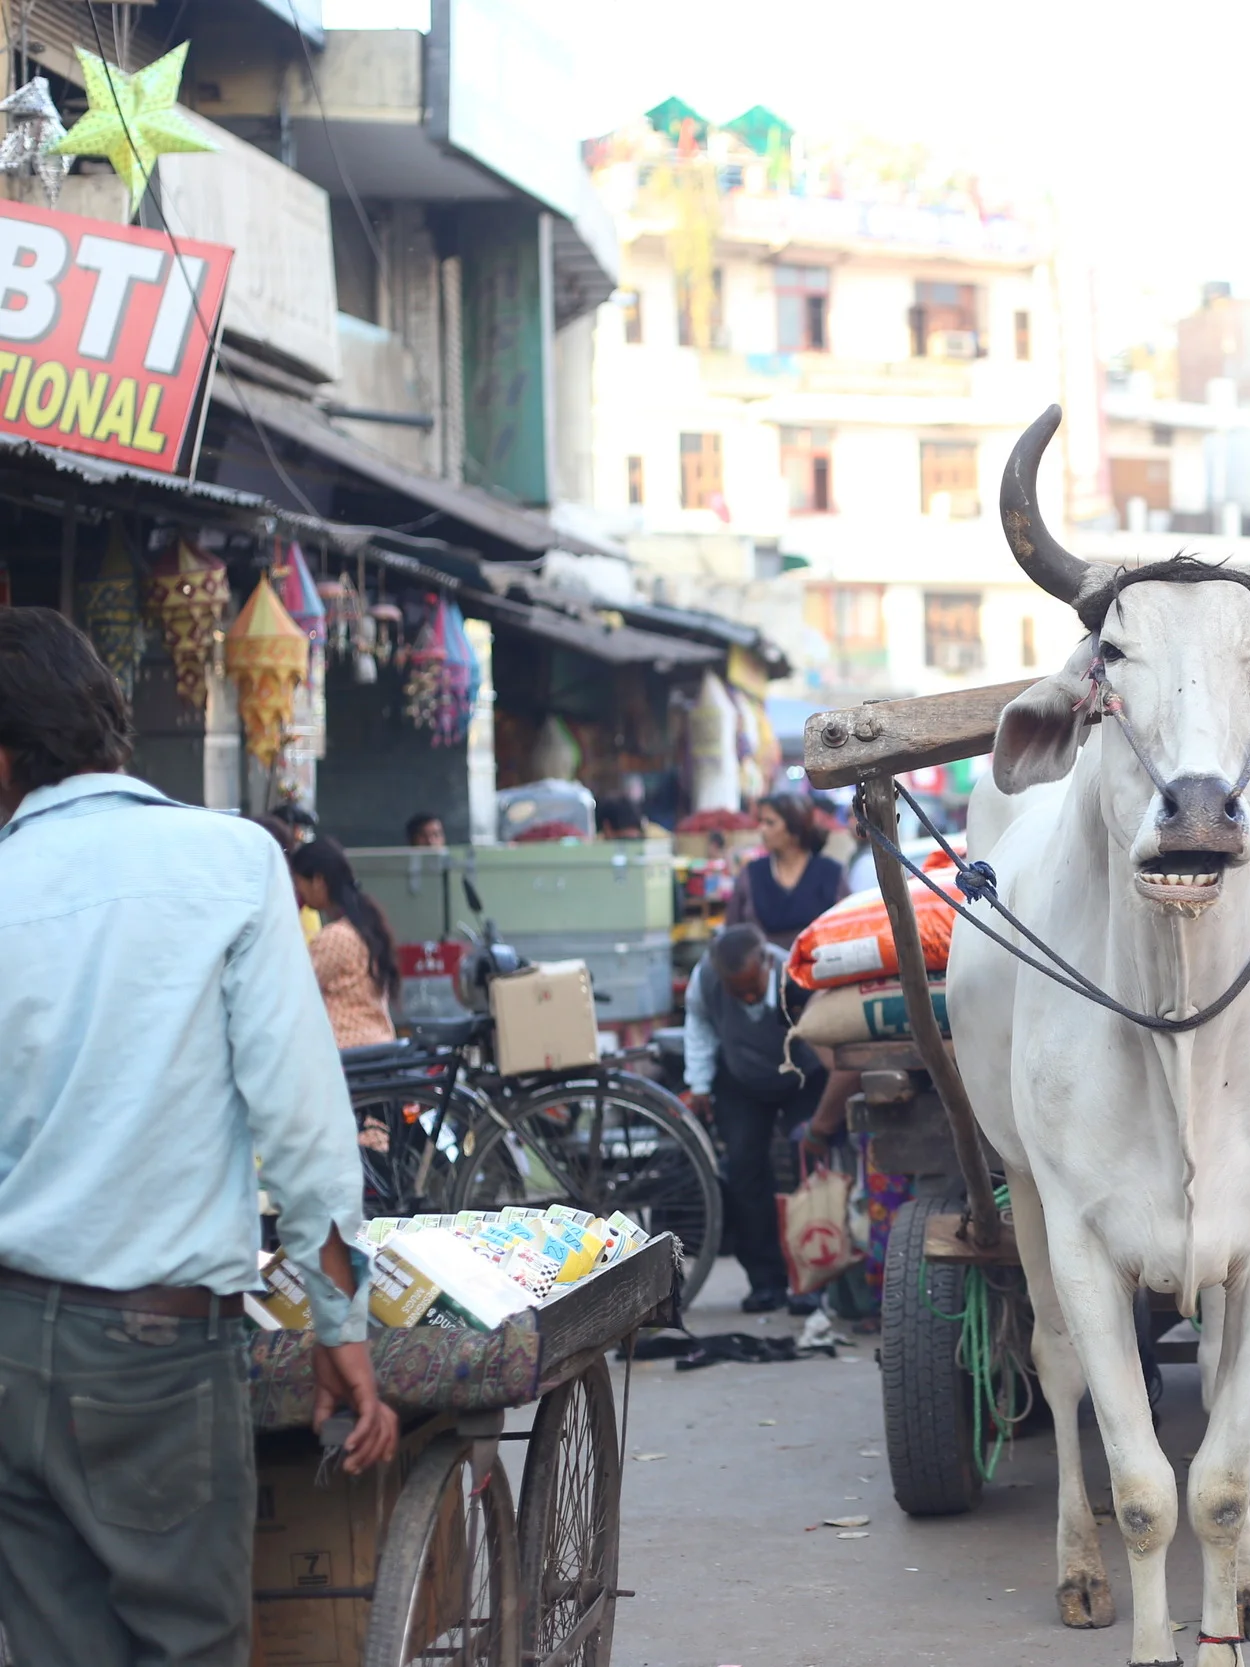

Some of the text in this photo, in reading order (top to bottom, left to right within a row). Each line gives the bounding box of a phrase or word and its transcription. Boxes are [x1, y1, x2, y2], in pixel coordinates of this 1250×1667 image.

[0, 215, 207, 375] BTI
[401, 1287, 426, 1314] MUGS
[403, 1285, 440, 1328] DESIGNER
